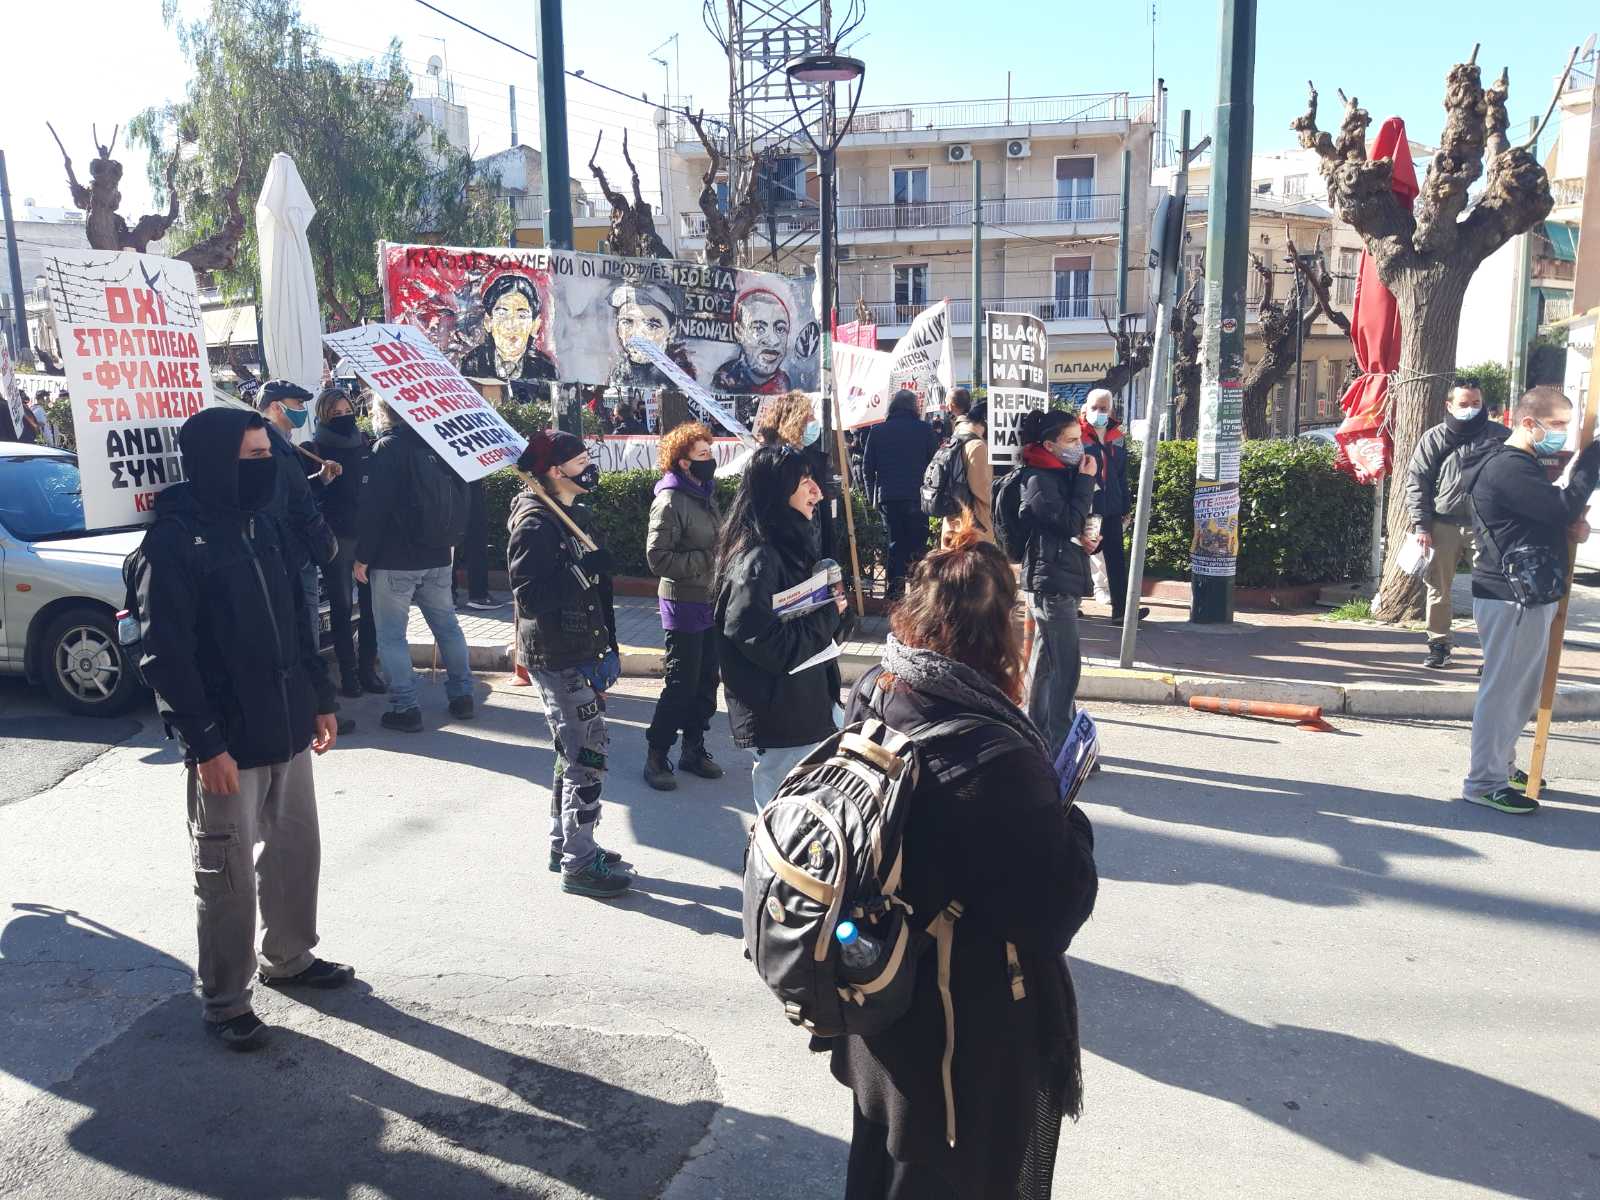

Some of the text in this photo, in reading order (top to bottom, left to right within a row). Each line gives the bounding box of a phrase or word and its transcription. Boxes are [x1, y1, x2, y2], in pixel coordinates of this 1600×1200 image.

[581, 261, 596, 277] ΟΙ
[602, 260, 670, 281] ΠΡΟΣΦΥΓΕΣ
[104, 286, 168, 325] ΟΧΙ
[685, 293, 731, 313] ΣΤΟΥΣ
[678, 318, 734, 341] ΝΕΟΝΑΖΙ
[992, 323, 1038, 344] BLACK
[72, 328, 200, 359] ΣΤΡΑΤΟΠΕΔΑ
[371, 341, 425, 366] ΟΧΙ
[992, 343, 1034, 362] LIVES
[370, 361, 458, 389] ΣΤΡΑΤΟΠΕΔΑ
[992, 363, 1043, 384] MATTER
[87, 398, 132, 423] ΣΤΑ
[993, 393, 1045, 412] REFUGEE
[407, 405, 441, 423] ΣΤΑ
[433, 411, 502, 440] ΑΝΟΙΧΤΑ
